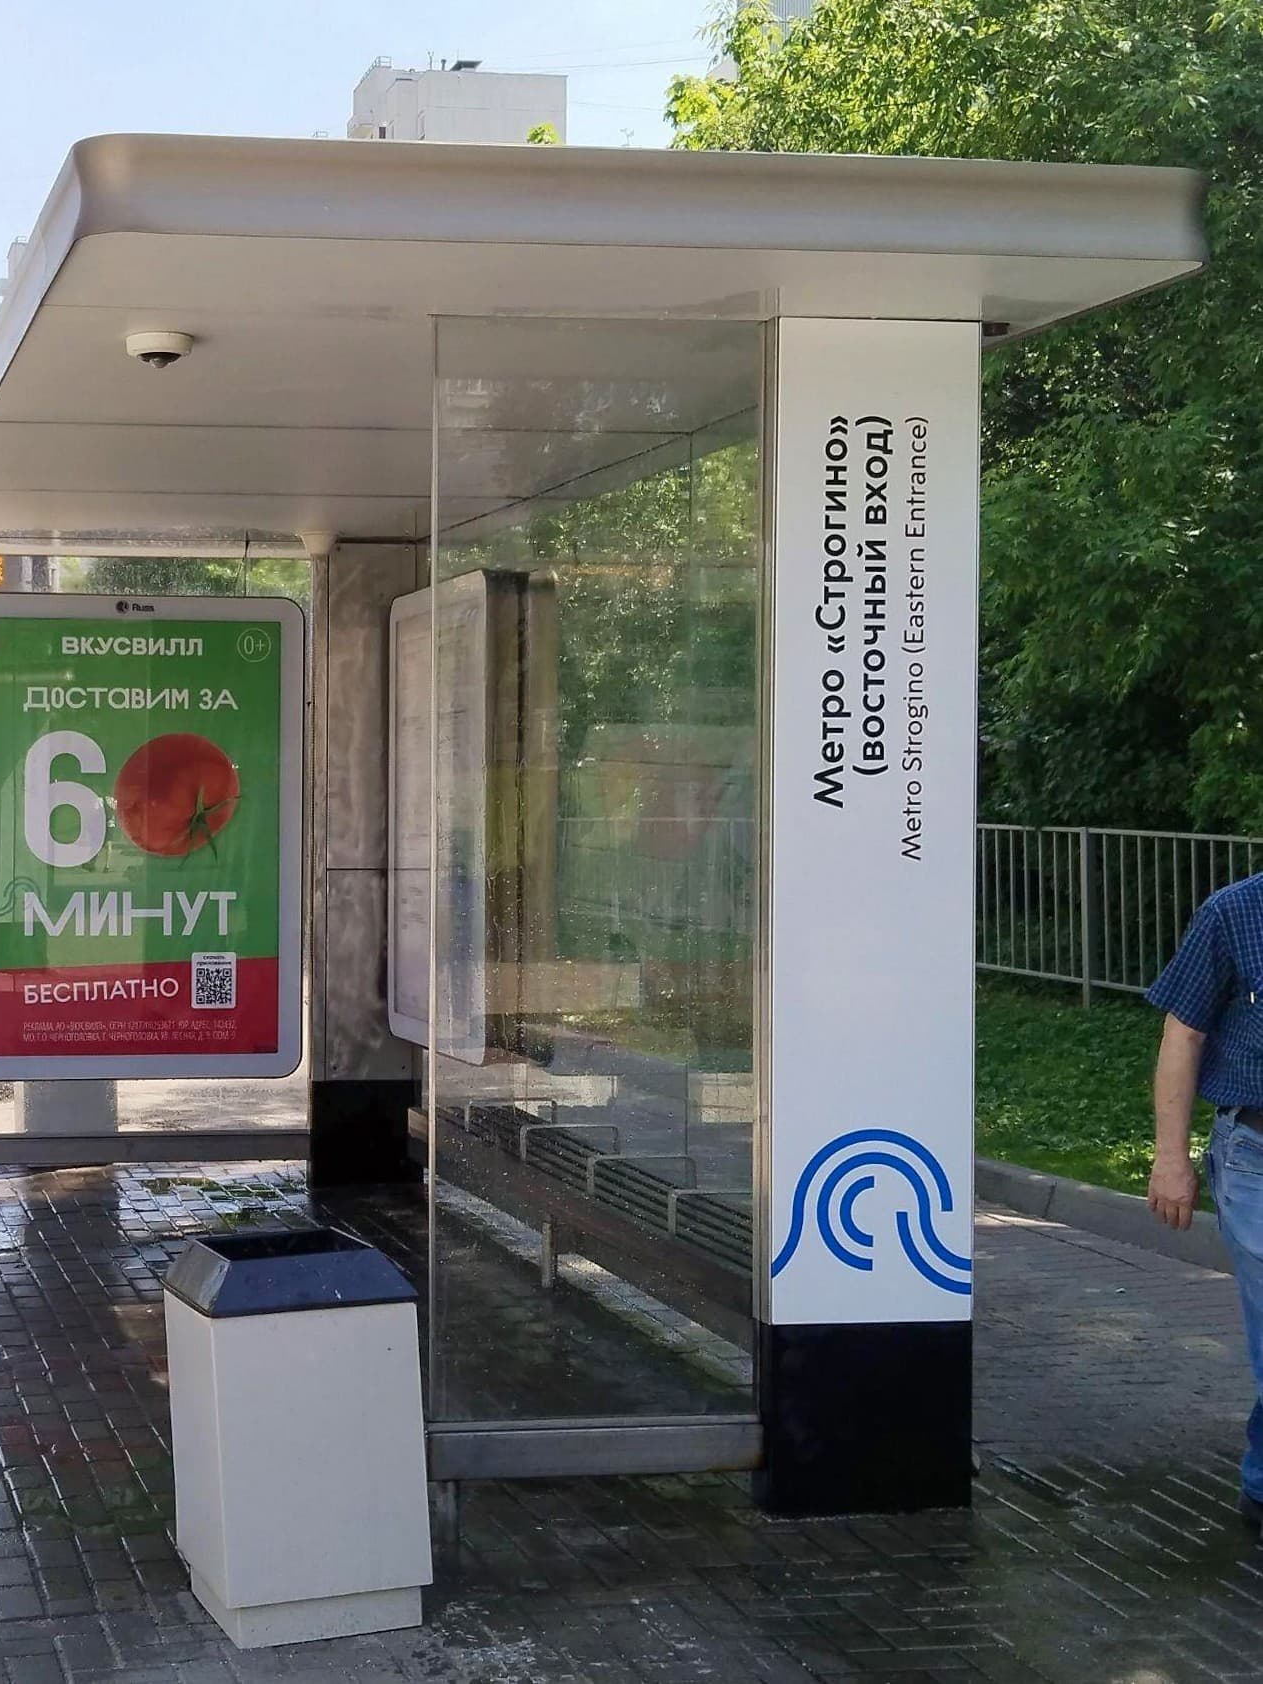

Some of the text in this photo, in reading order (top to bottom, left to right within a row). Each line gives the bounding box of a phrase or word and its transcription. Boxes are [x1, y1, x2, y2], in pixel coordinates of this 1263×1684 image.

[813, 415, 854, 809] Метро «Строгино»
[852, 415, 894, 776] (восточный вход)
[61, 636, 203, 656] ВКУСВИЛЛ
[243, 635, 266, 656] 0+
[901, 416, 929, 861] Metro Strogino (Eastern Entrance)
[23, 686, 239, 712] ДОСТАВИМ ЗА
[24, 891, 237, 937] МИНУТ
[23, 978, 179, 1005] БЕСПЛАТНО
